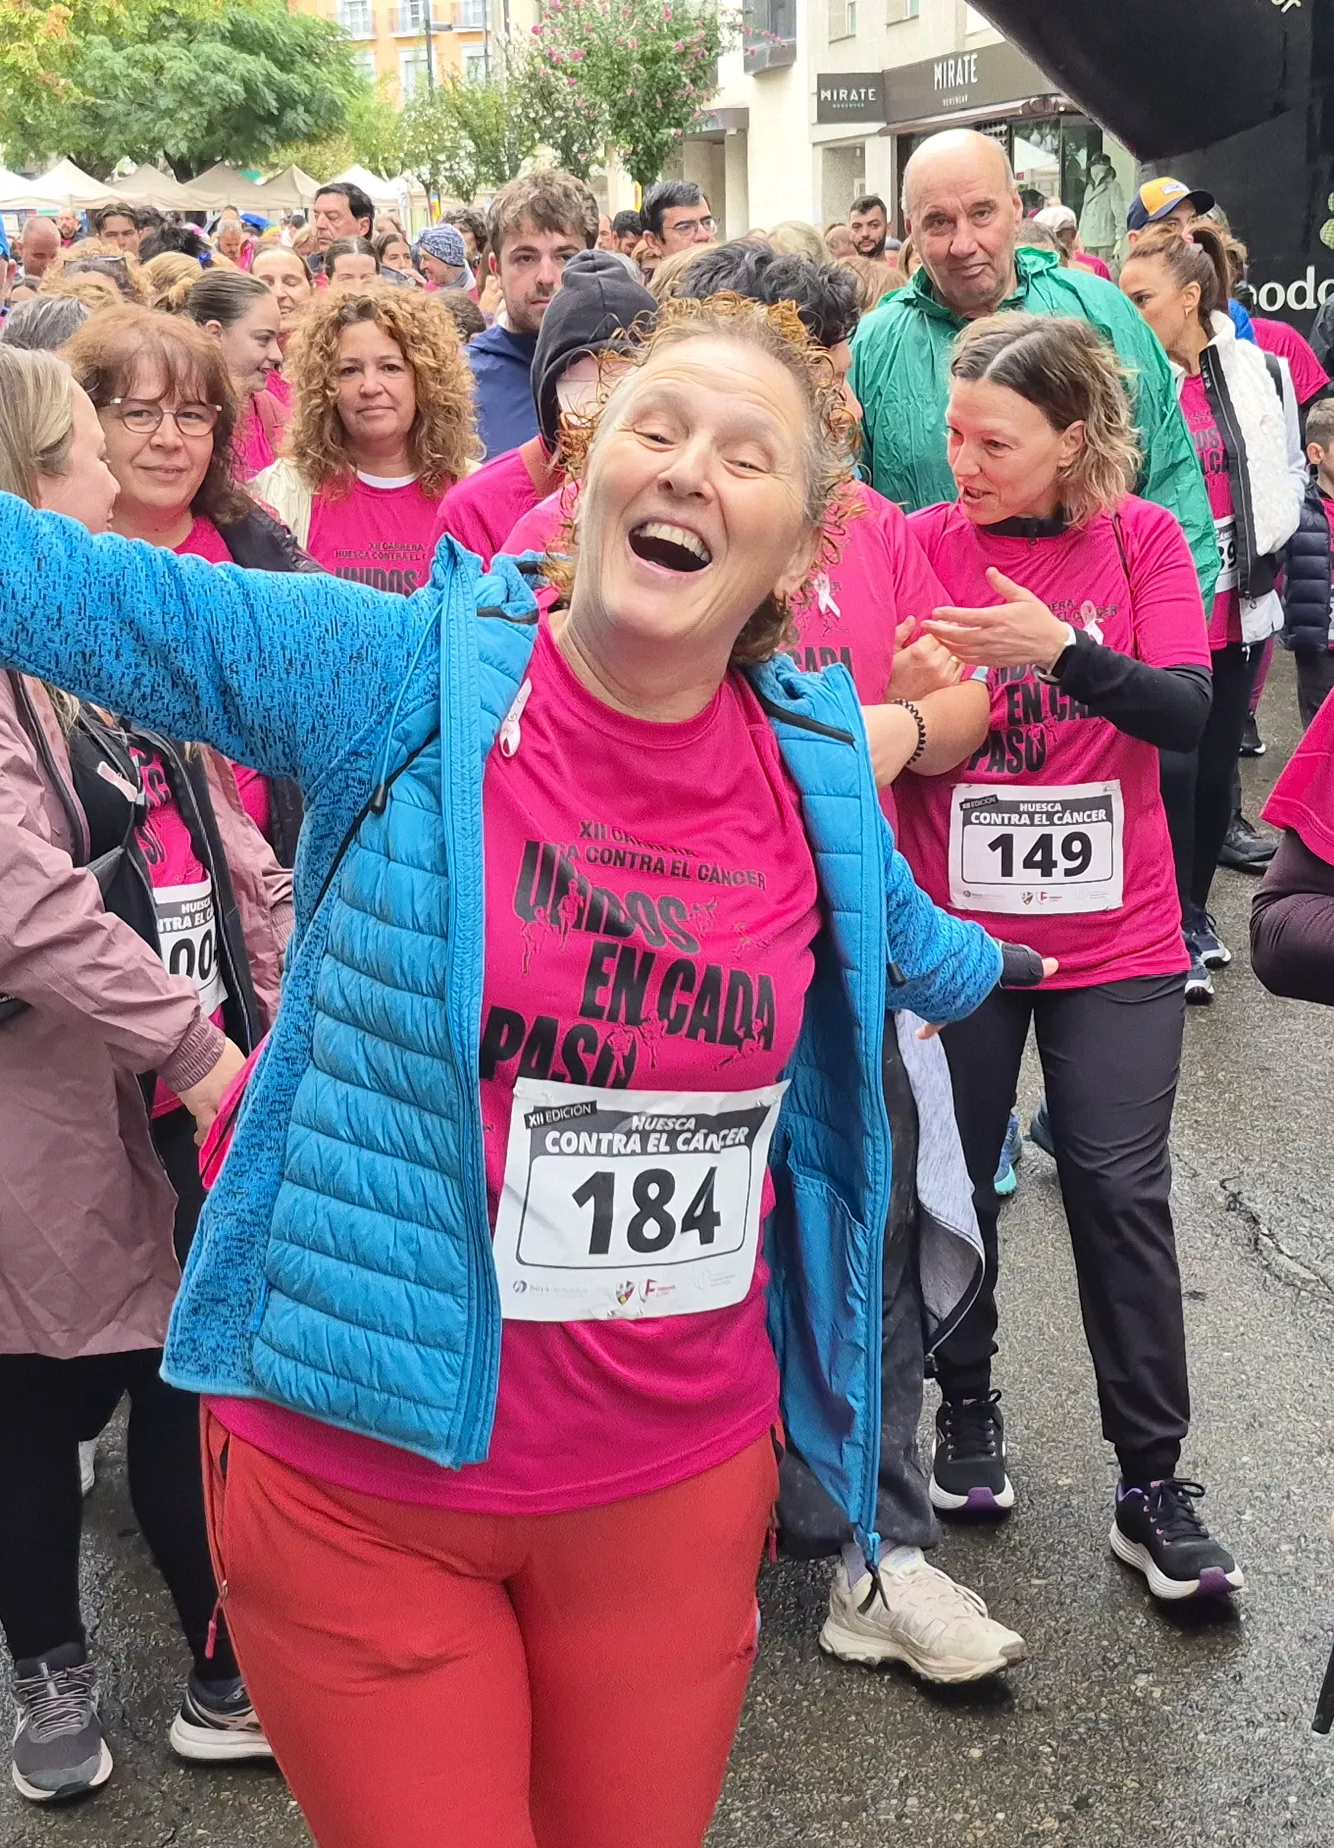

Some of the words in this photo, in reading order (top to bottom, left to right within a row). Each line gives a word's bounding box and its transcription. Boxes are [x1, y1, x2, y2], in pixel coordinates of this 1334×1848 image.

[934, 53, 978, 90] MIRATE
[820, 88, 877, 102] MIRATE
[335, 550, 369, 559] HUESCA
[372, 551, 408, 560] CONTRA
[382, 542, 424, 551] CARRERA
[1006, 683, 1044, 726] EN
[970, 812, 1031, 825] CONTRA
[1034, 813, 1050, 825] EL
[1053, 808, 1107, 824] CÁNCER
[1019, 802, 1062, 812] HUESCA
[579, 820, 607, 840] XII
[586, 845, 665, 875] CONTRA
[669, 859, 692, 879] EL
[987, 831, 1093, 878] 149
[514, 840, 700, 954] UNIDOS
[194, 913, 207, 927] EL
[578, 939, 656, 1026] EN
[658, 957, 776, 1052] CADA
[479, 1005, 638, 1090] PASO
[528, 1112, 545, 1126] XII
[545, 1103, 591, 1122] EDICIÓN
[631, 1115, 696, 1131] HUESCA
[544, 1130, 642, 1155] CONTRA
[646, 1132, 670, 1153] EL
[676, 1127, 750, 1151] CÁNCER
[571, 1166, 722, 1256] 184
